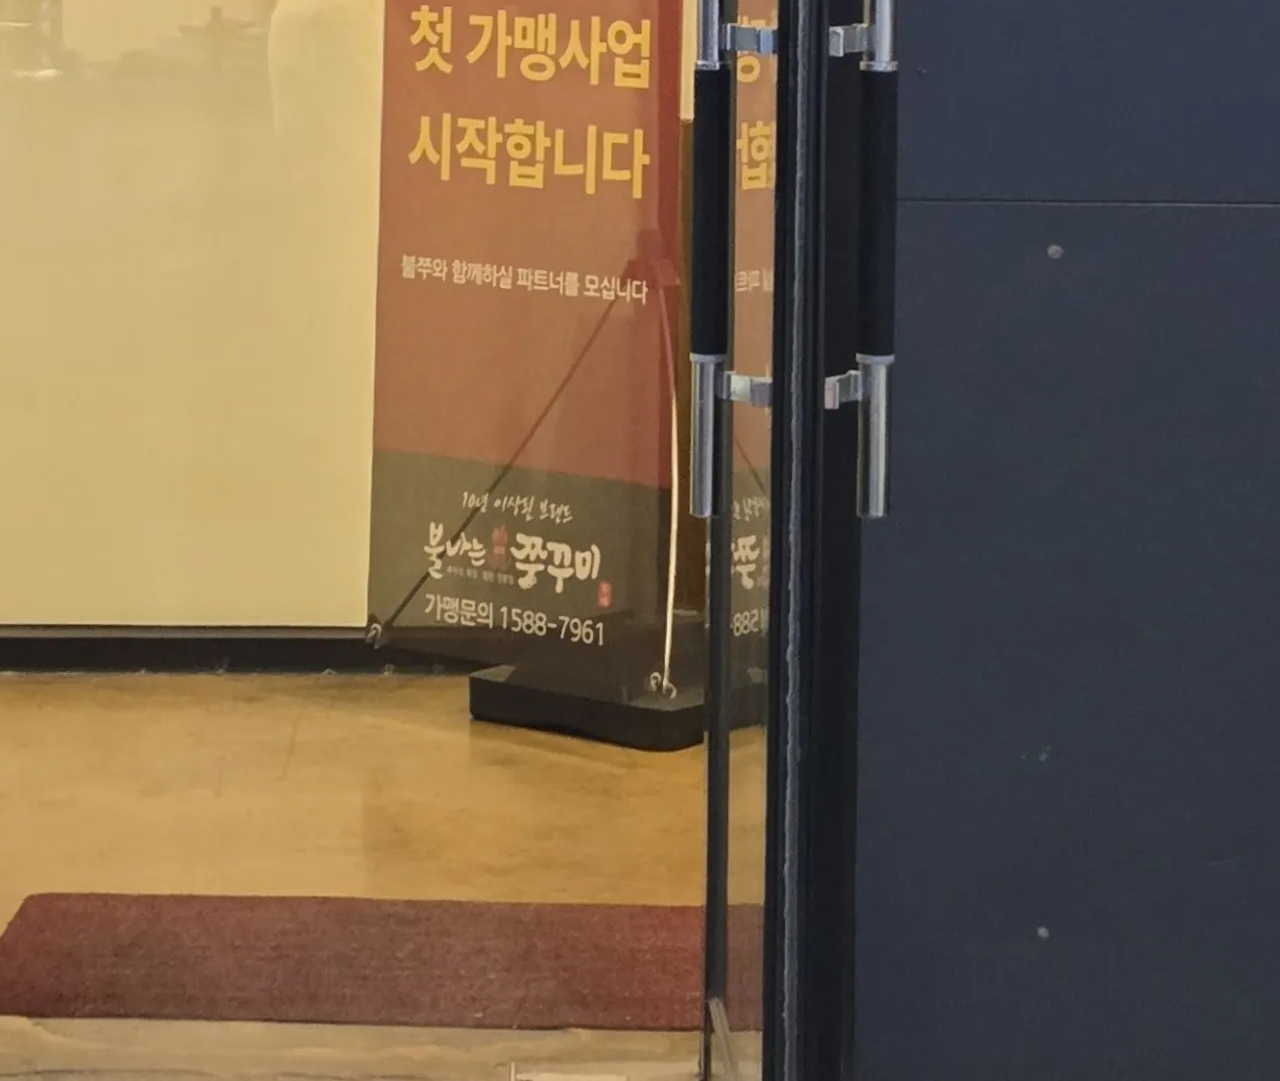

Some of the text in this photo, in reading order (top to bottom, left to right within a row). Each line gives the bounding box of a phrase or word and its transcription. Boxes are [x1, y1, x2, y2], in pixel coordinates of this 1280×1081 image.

[410, 5, 651, 89] 첫 가맹사업
[409, 113, 650, 199] 시작합니다
[452, 259, 513, 289] 함께하실
[517, 268, 579, 296] 파트너를
[583, 275, 648, 305] 모십니다
[424, 522, 486, 579] 불나는
[425, 594, 603, 646] 가맹문의 1588-7961
